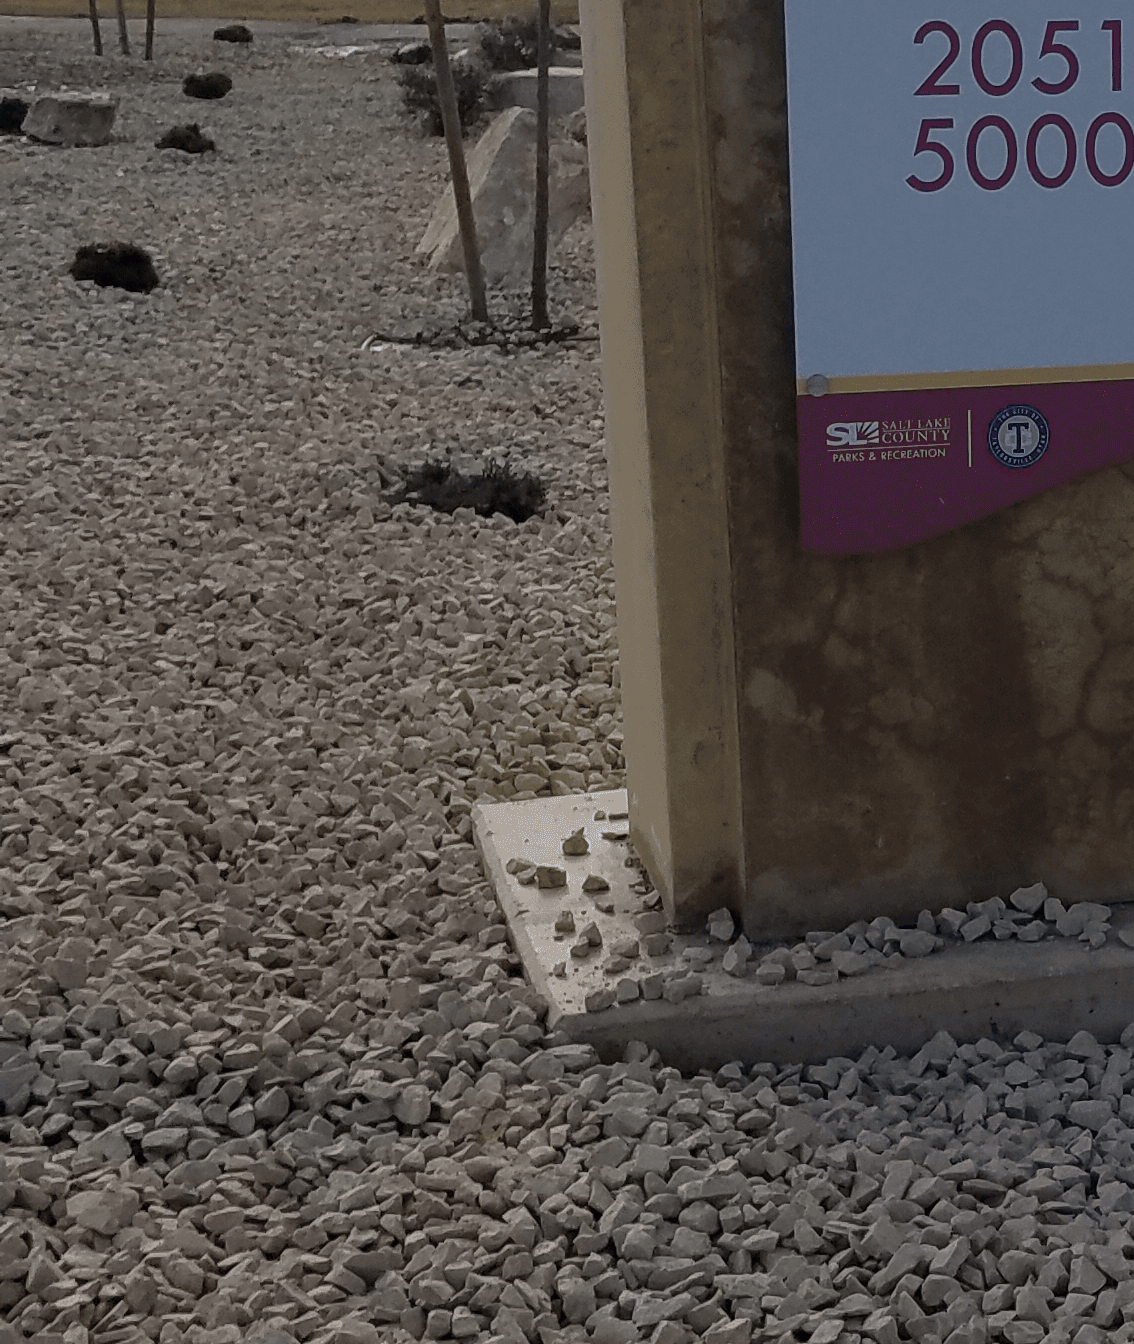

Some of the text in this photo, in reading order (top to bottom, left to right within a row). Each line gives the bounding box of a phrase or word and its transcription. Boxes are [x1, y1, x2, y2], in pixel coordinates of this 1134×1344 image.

[914, 20, 1121, 96] 2051
[906, 112, 1134, 192] 5000
[881, 429, 950, 444] COUNTY
[1007, 422, 1030, 454] T
[832, 448, 946, 463] PARKS & RECREATION
